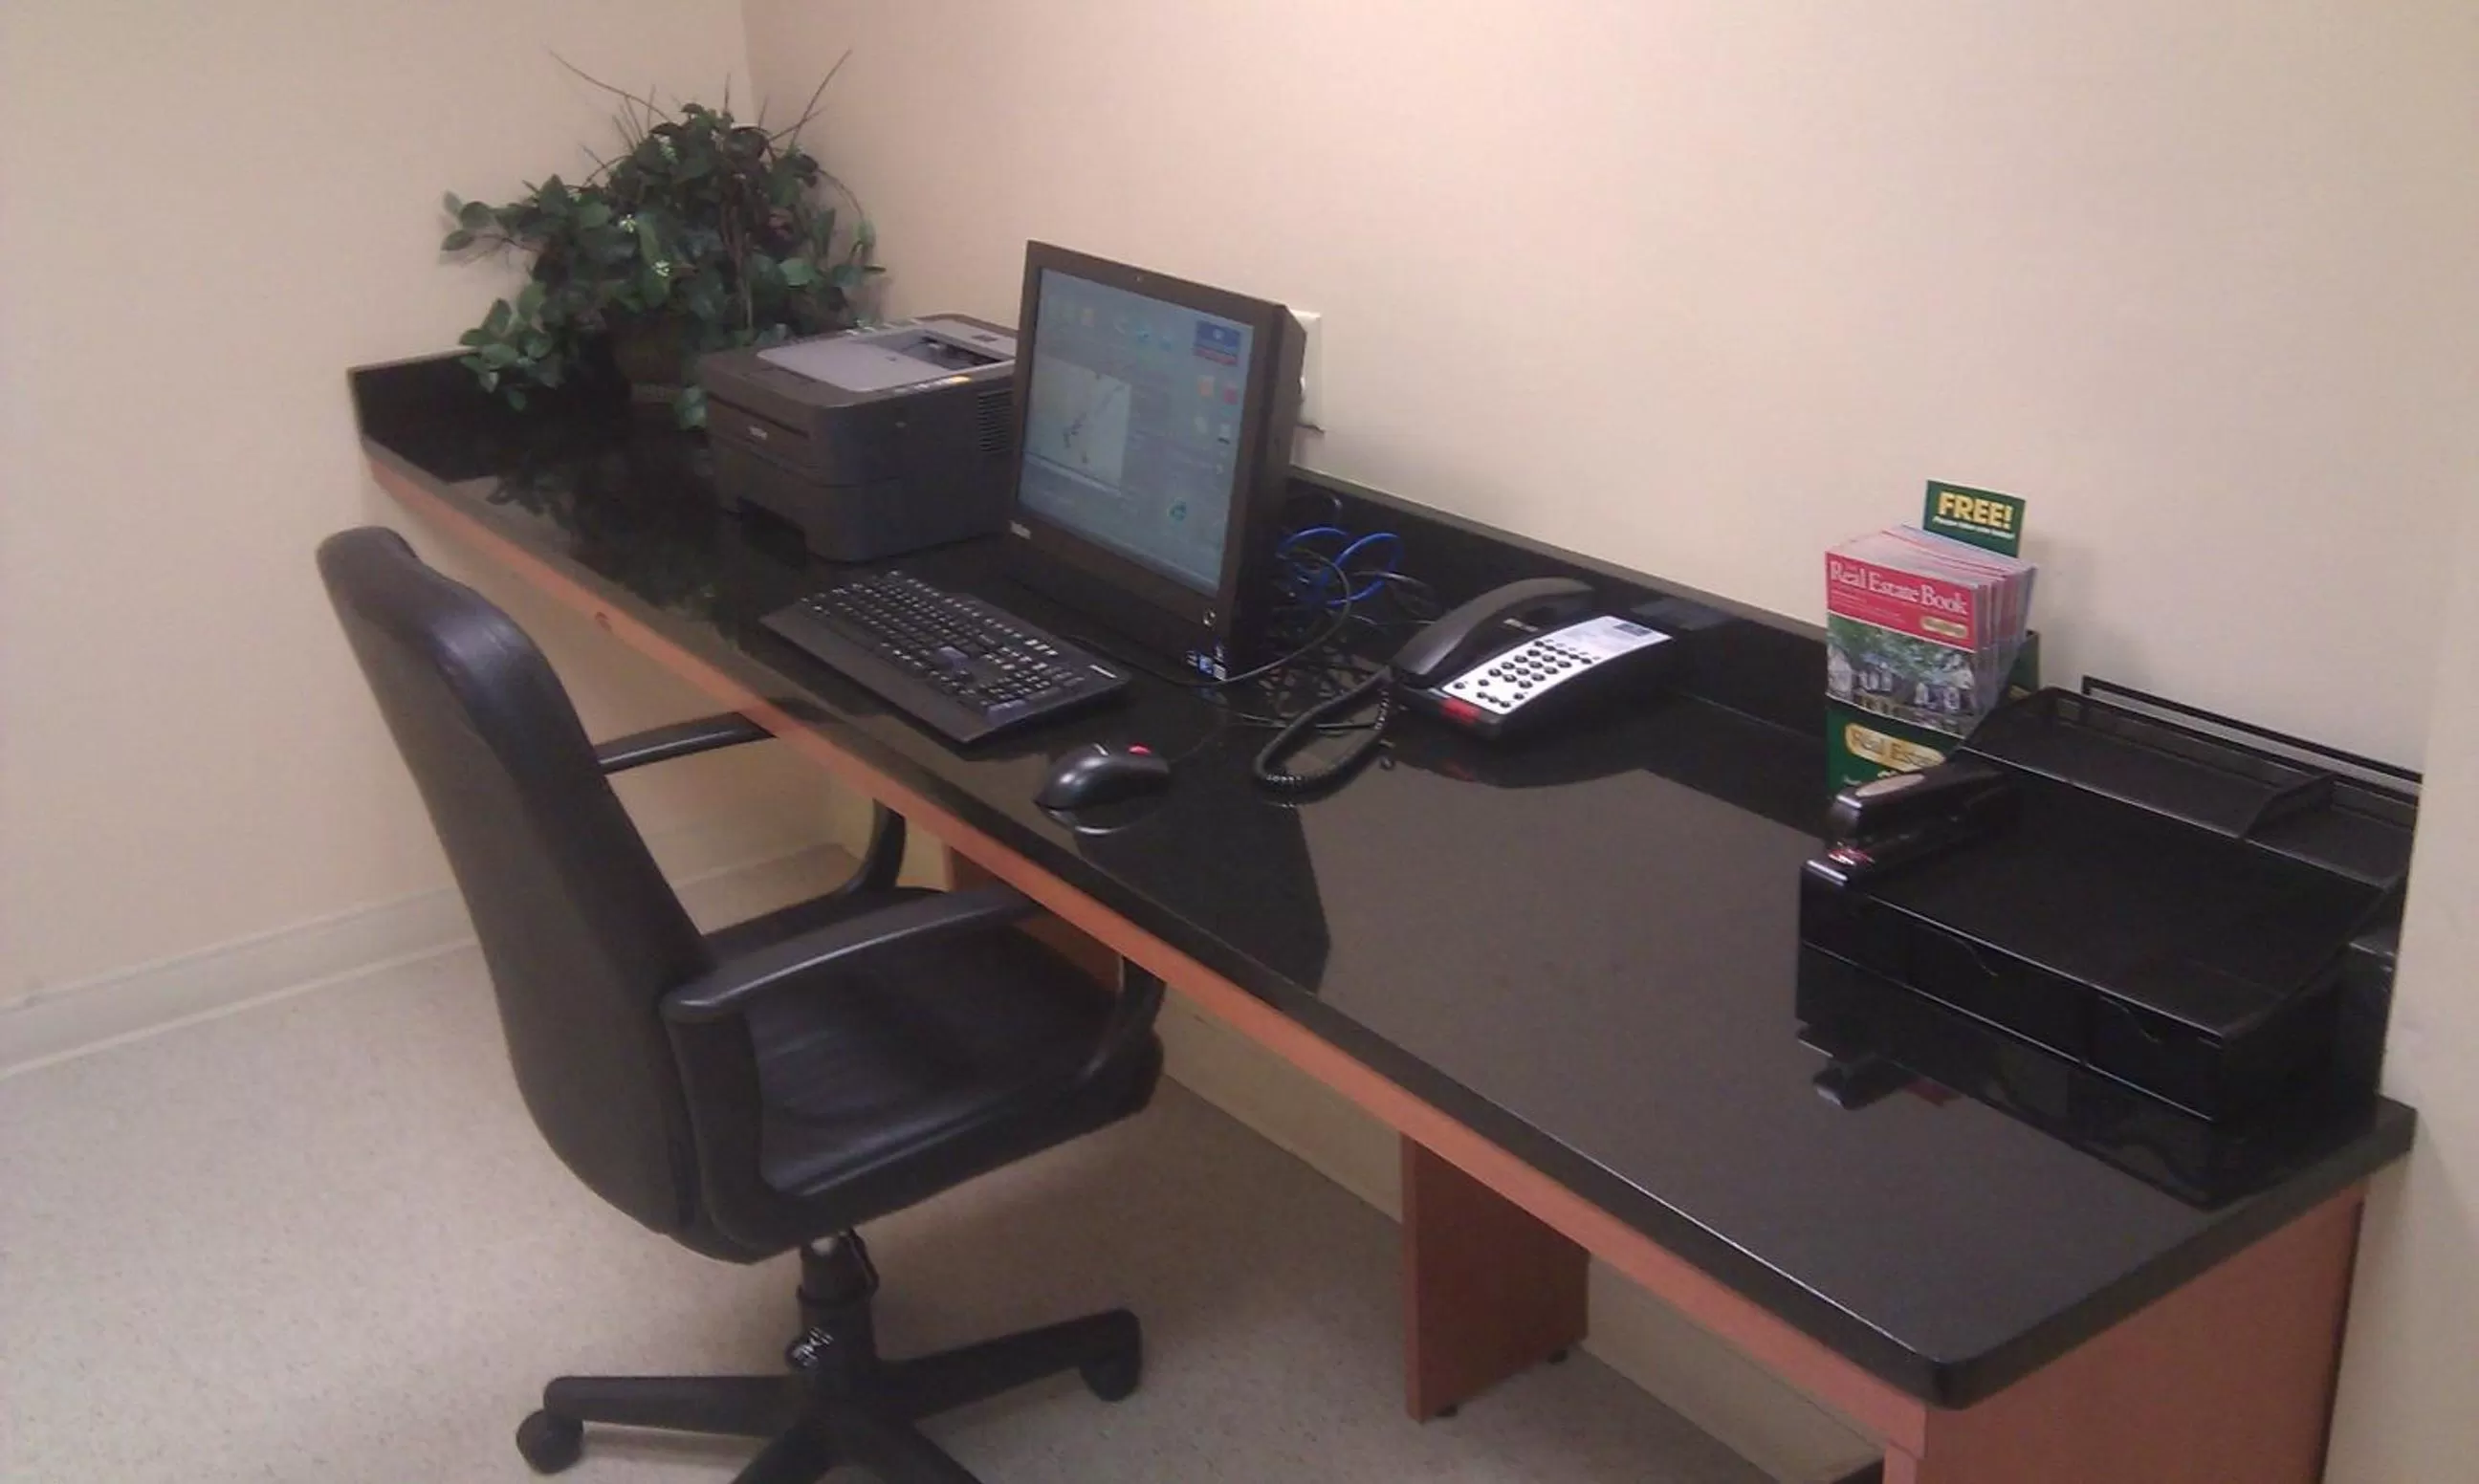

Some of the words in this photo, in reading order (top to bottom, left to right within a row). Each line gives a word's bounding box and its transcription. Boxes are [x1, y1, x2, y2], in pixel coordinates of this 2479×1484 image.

[1938, 491, 2013, 531] FREE!
[1829, 559, 1867, 590] Real
[1868, 571, 1920, 602] Estate
[1920, 583, 1968, 615] Book
